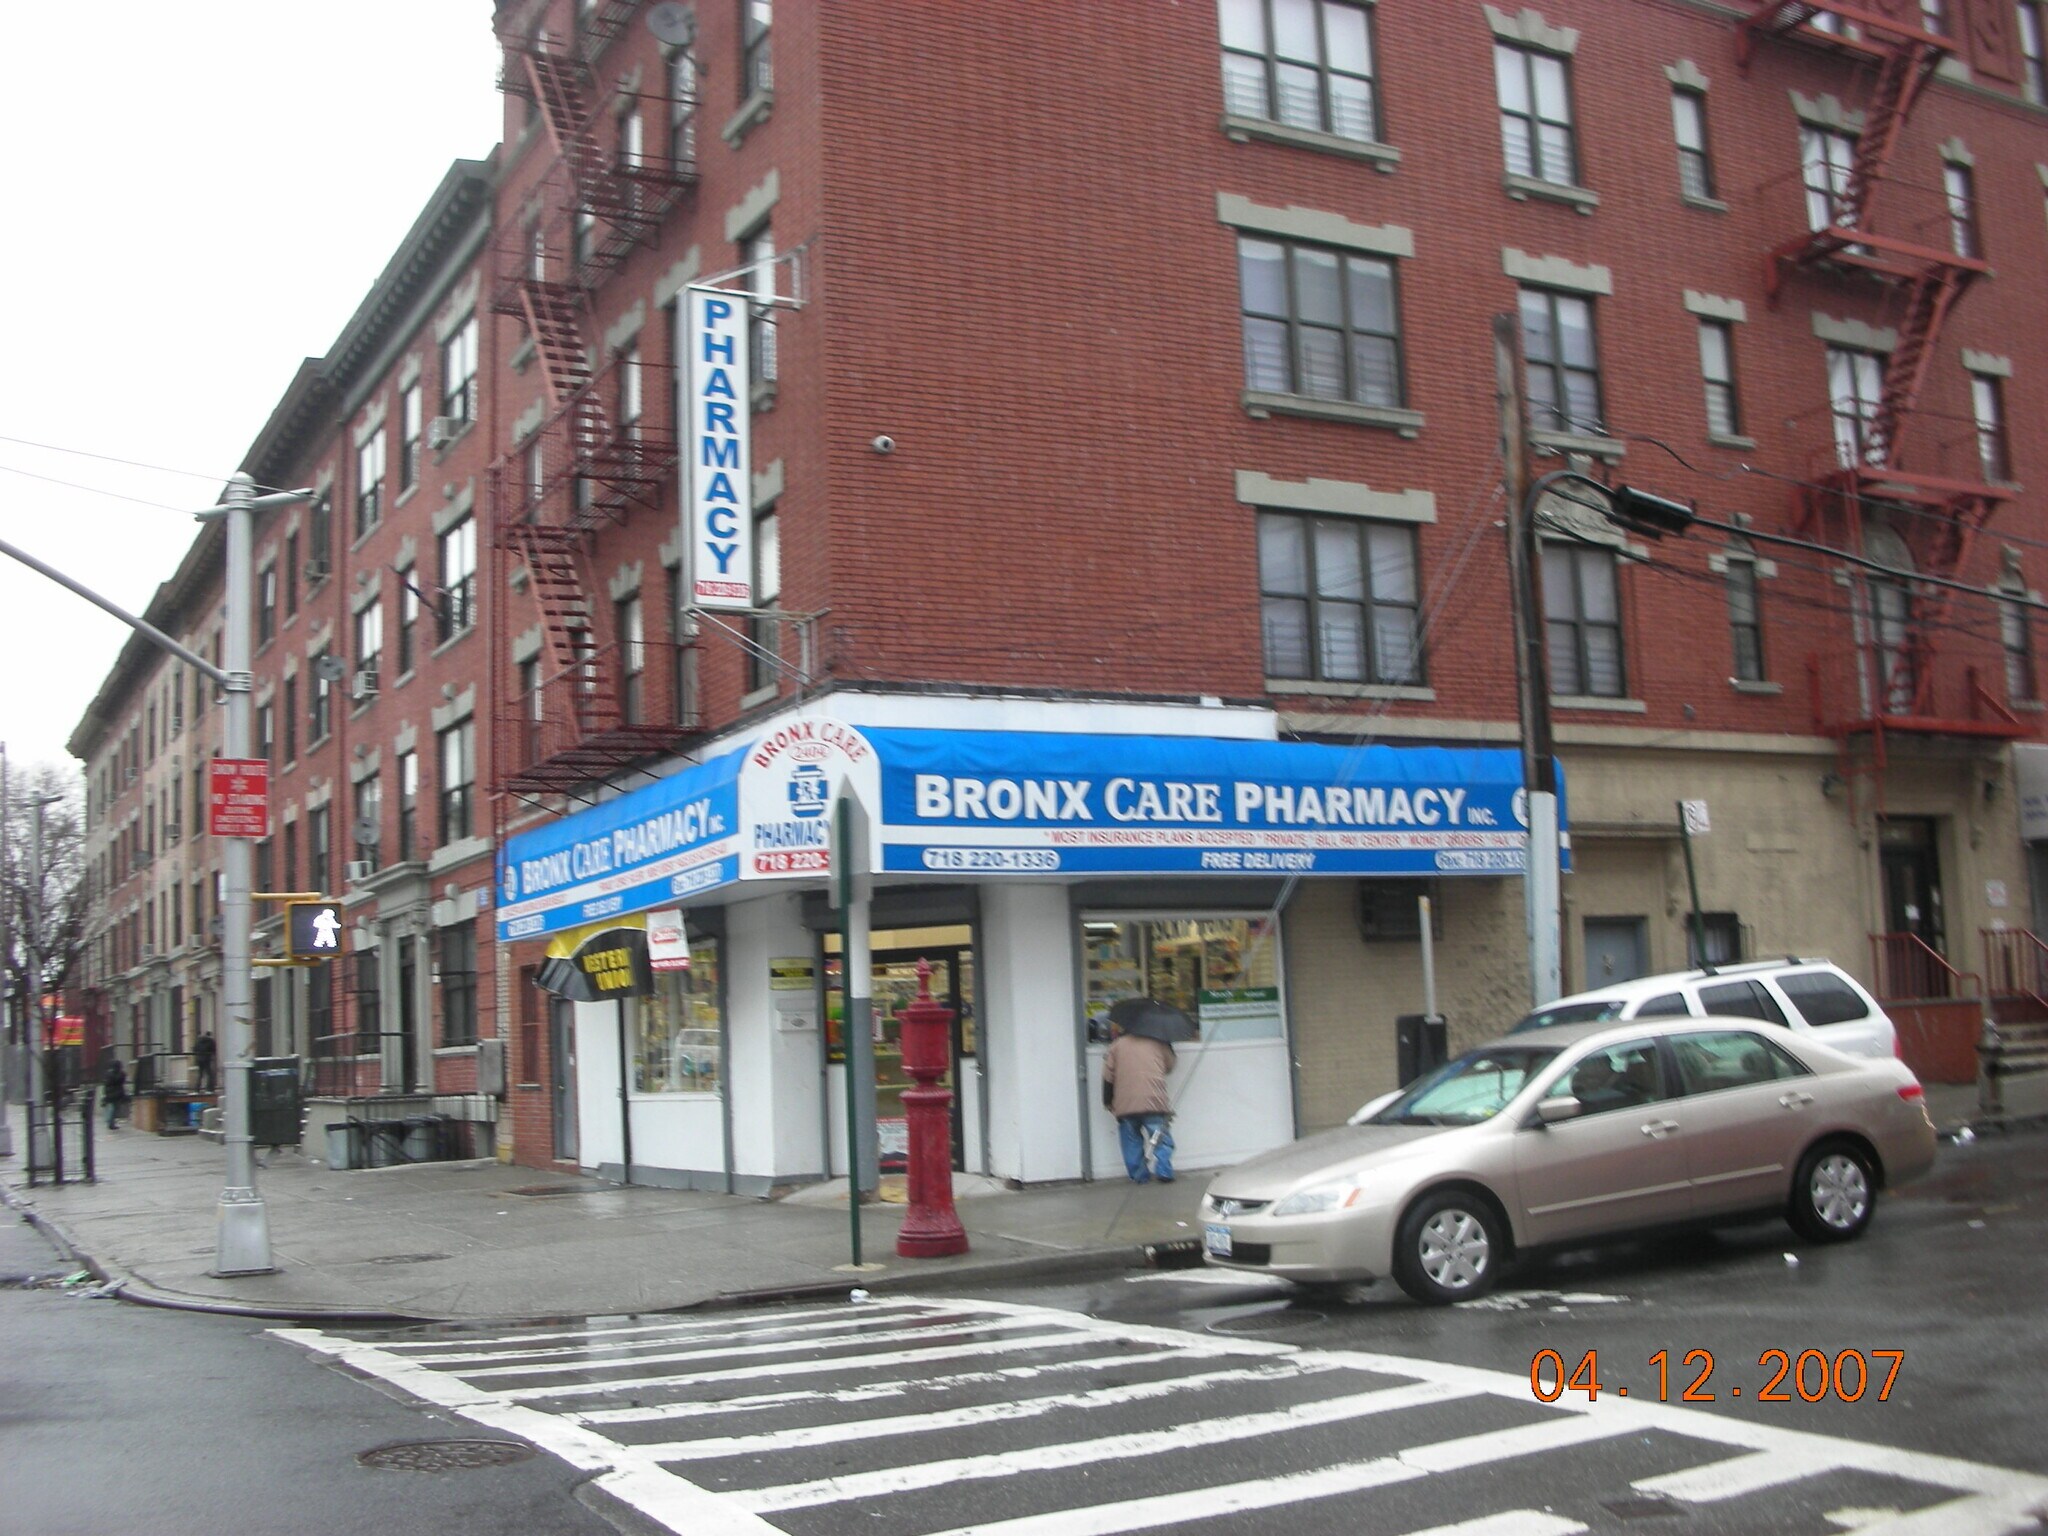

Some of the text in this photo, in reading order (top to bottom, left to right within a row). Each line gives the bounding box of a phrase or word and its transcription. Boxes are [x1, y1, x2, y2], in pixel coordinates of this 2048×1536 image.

[702, 298, 740, 574] PHARMACY
[753, 721, 869, 769] BRONX CARE
[914, 773, 1094, 821] BRONX
[1104, 777, 1223, 823] CARE
[1233, 781, 1467, 826] PHARMACY
[521, 849, 573, 895] BRONX
[572, 836, 613, 880] CARE
[613, 797, 712, 868] PHARMACY
[1087, 830, 1154, 845] INSURANCE
[1156, 831, 1194, 845] PLANS
[756, 852, 789, 870] 718
[927, 850, 1057, 868] 718 220-1336
[1201, 851, 1317, 870] FREE DELIVERY
